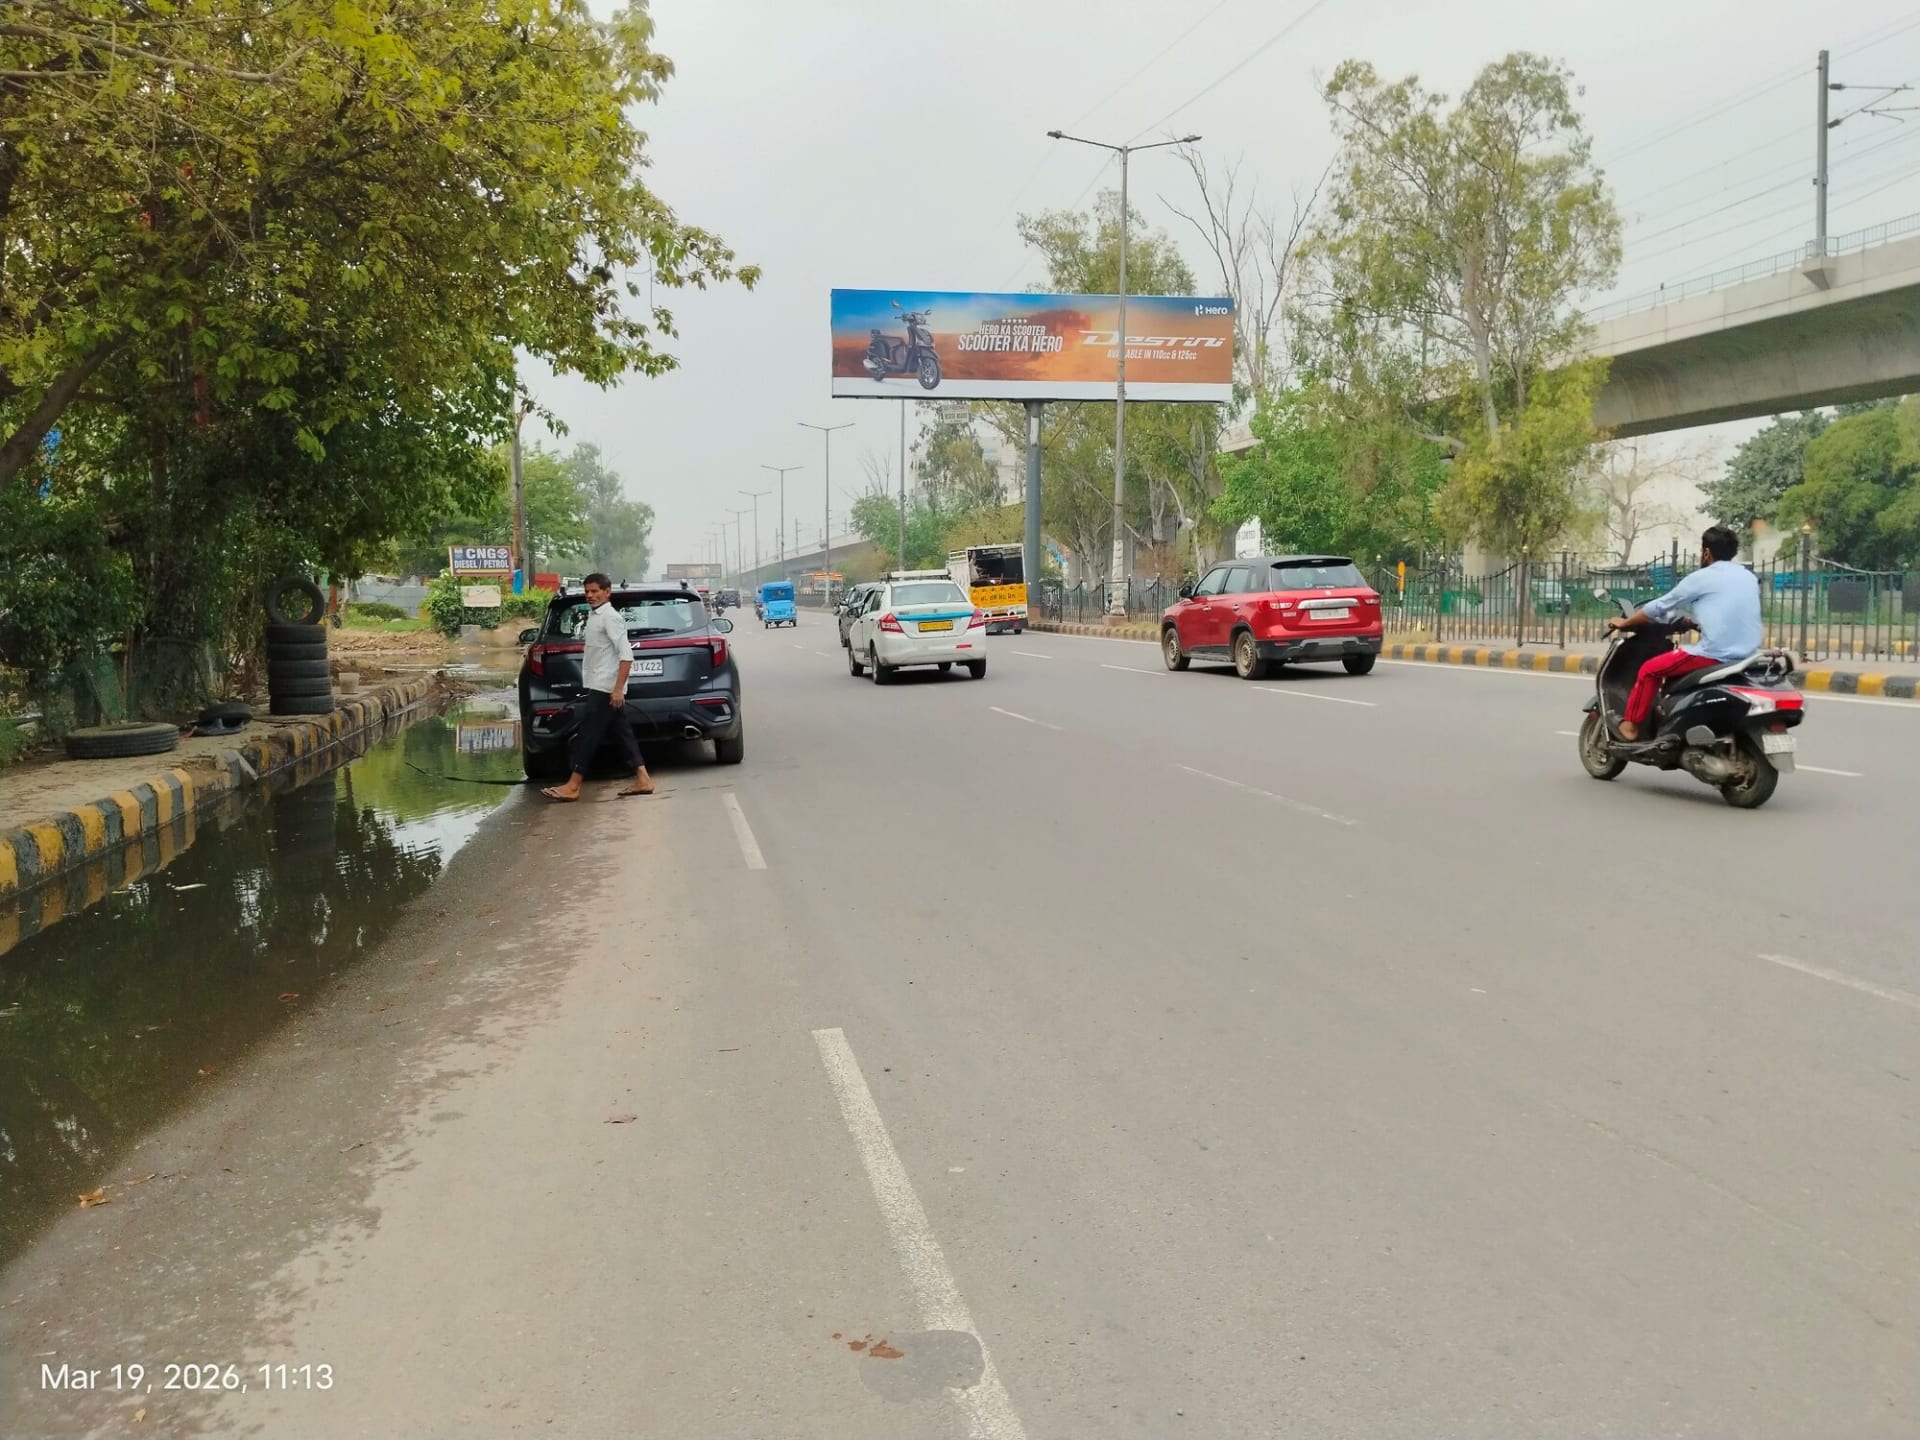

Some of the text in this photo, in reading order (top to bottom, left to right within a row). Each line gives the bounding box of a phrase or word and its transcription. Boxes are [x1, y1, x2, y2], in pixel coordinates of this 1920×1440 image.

[979, 324, 1046, 336] HERO KA SCOOTER
[958, 334, 1064, 352] SCOOTER KA HERO
[1143, 349, 1152, 359] IN
[465, 548, 497, 560] CNG
[454, 560, 478, 569] DIESEL
[483, 559, 509, 569] PETROL
